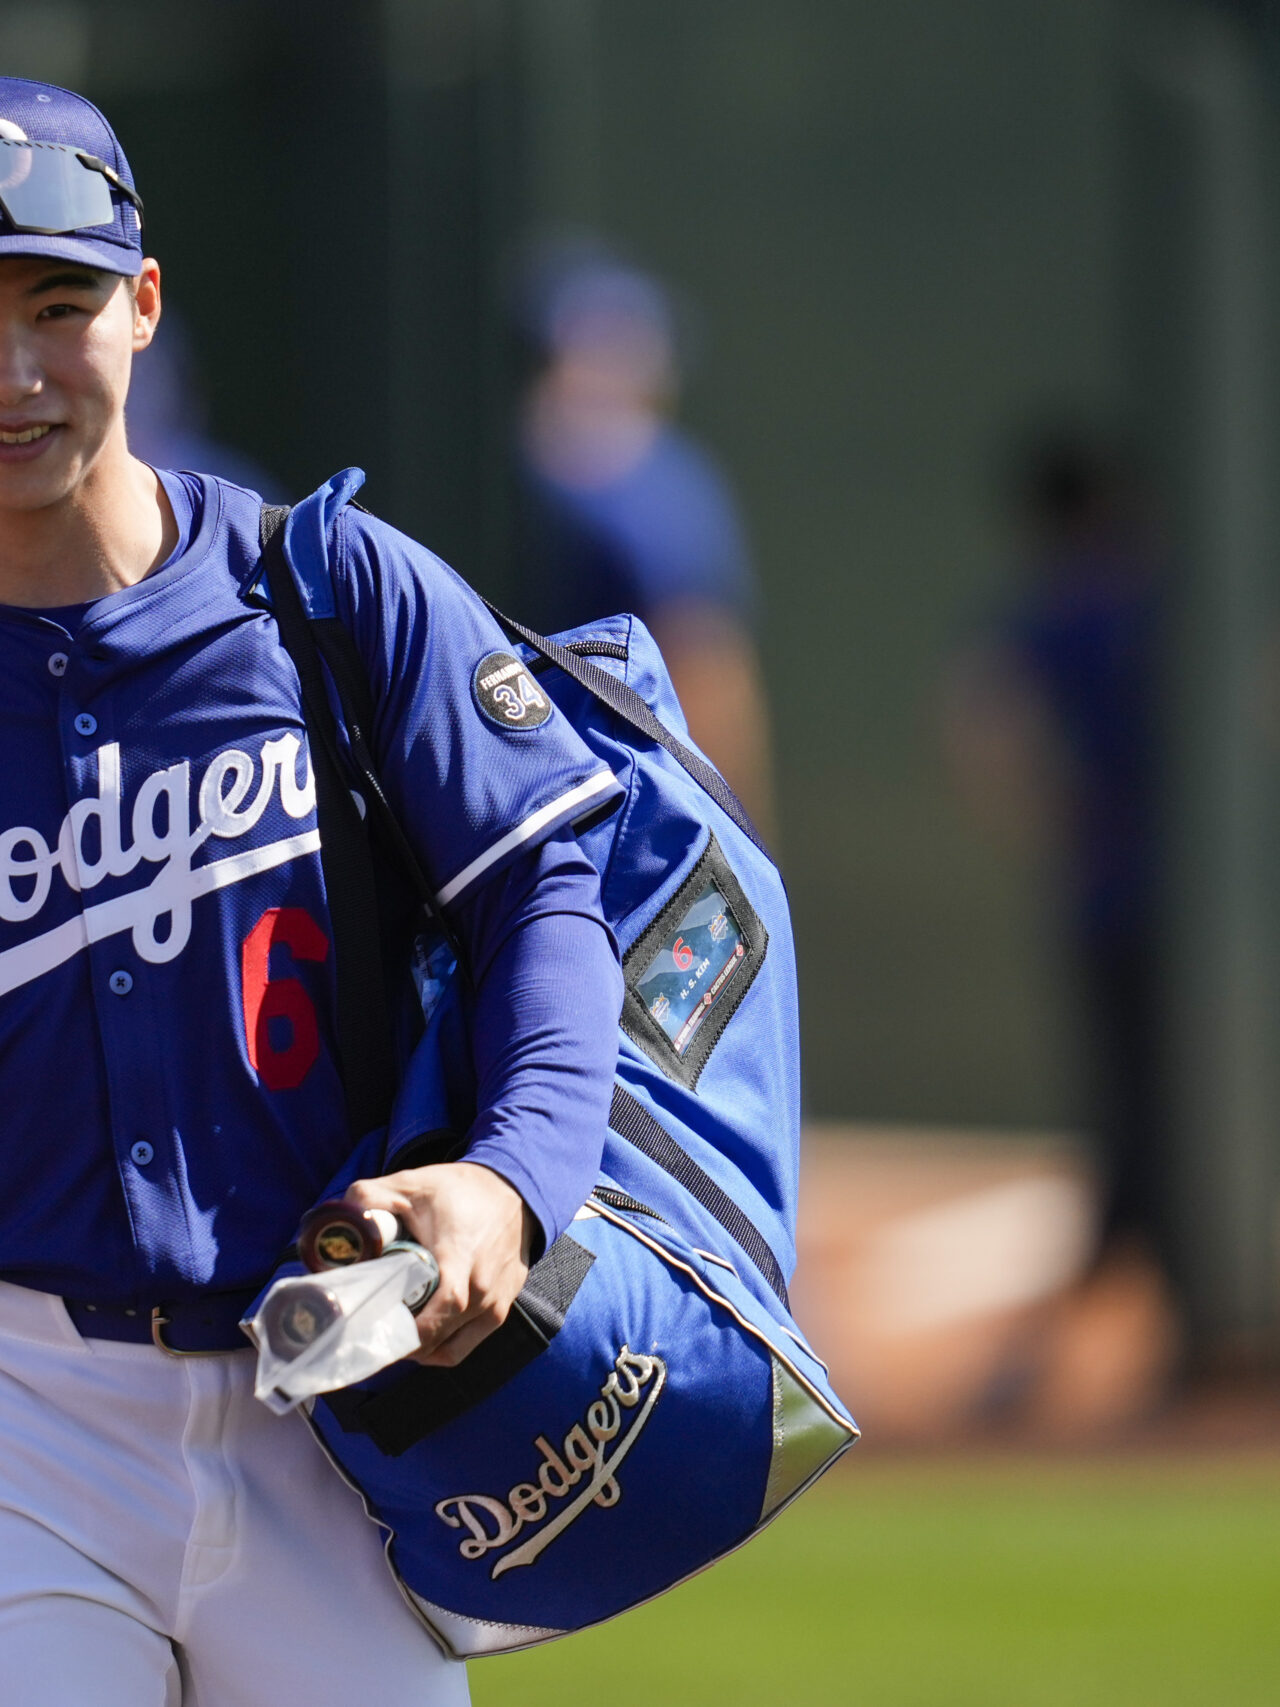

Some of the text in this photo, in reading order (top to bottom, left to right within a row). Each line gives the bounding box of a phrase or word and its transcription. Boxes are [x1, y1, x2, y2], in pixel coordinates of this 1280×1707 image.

[494, 674, 545, 720] 34
[672, 936, 693, 971] 6
[242, 906, 330, 1090] 6
[680, 957, 710, 1000] H. S. KIM
[435, 1343, 667, 1580] Dodgers
